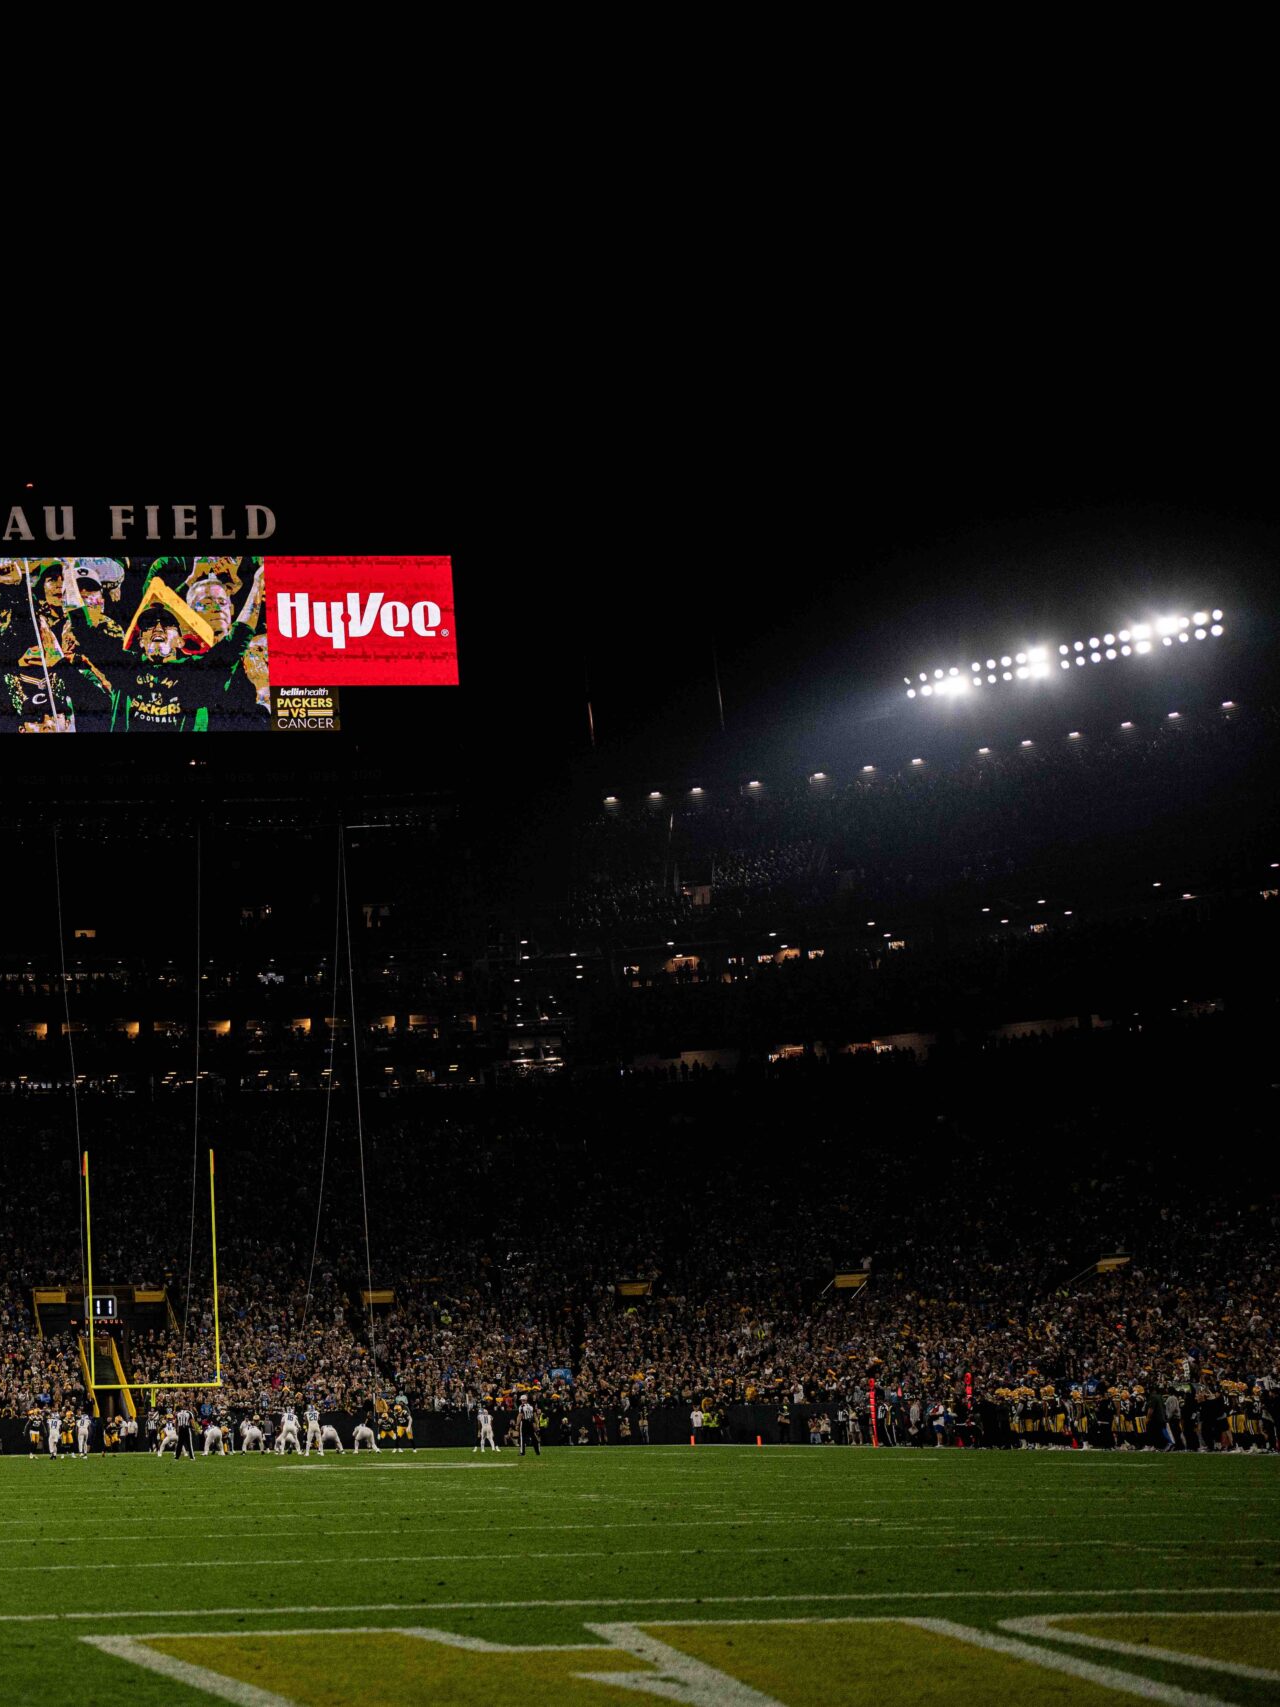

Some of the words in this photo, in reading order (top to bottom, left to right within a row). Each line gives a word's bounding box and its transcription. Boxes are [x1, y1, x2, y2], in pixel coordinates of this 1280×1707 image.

[109, 504, 277, 540] FIELD
[276, 697, 333, 708] PACKERS
[290, 708, 307, 718] VS
[277, 717, 335, 729] CANCER
[96, 1300, 113, 1315] 11
